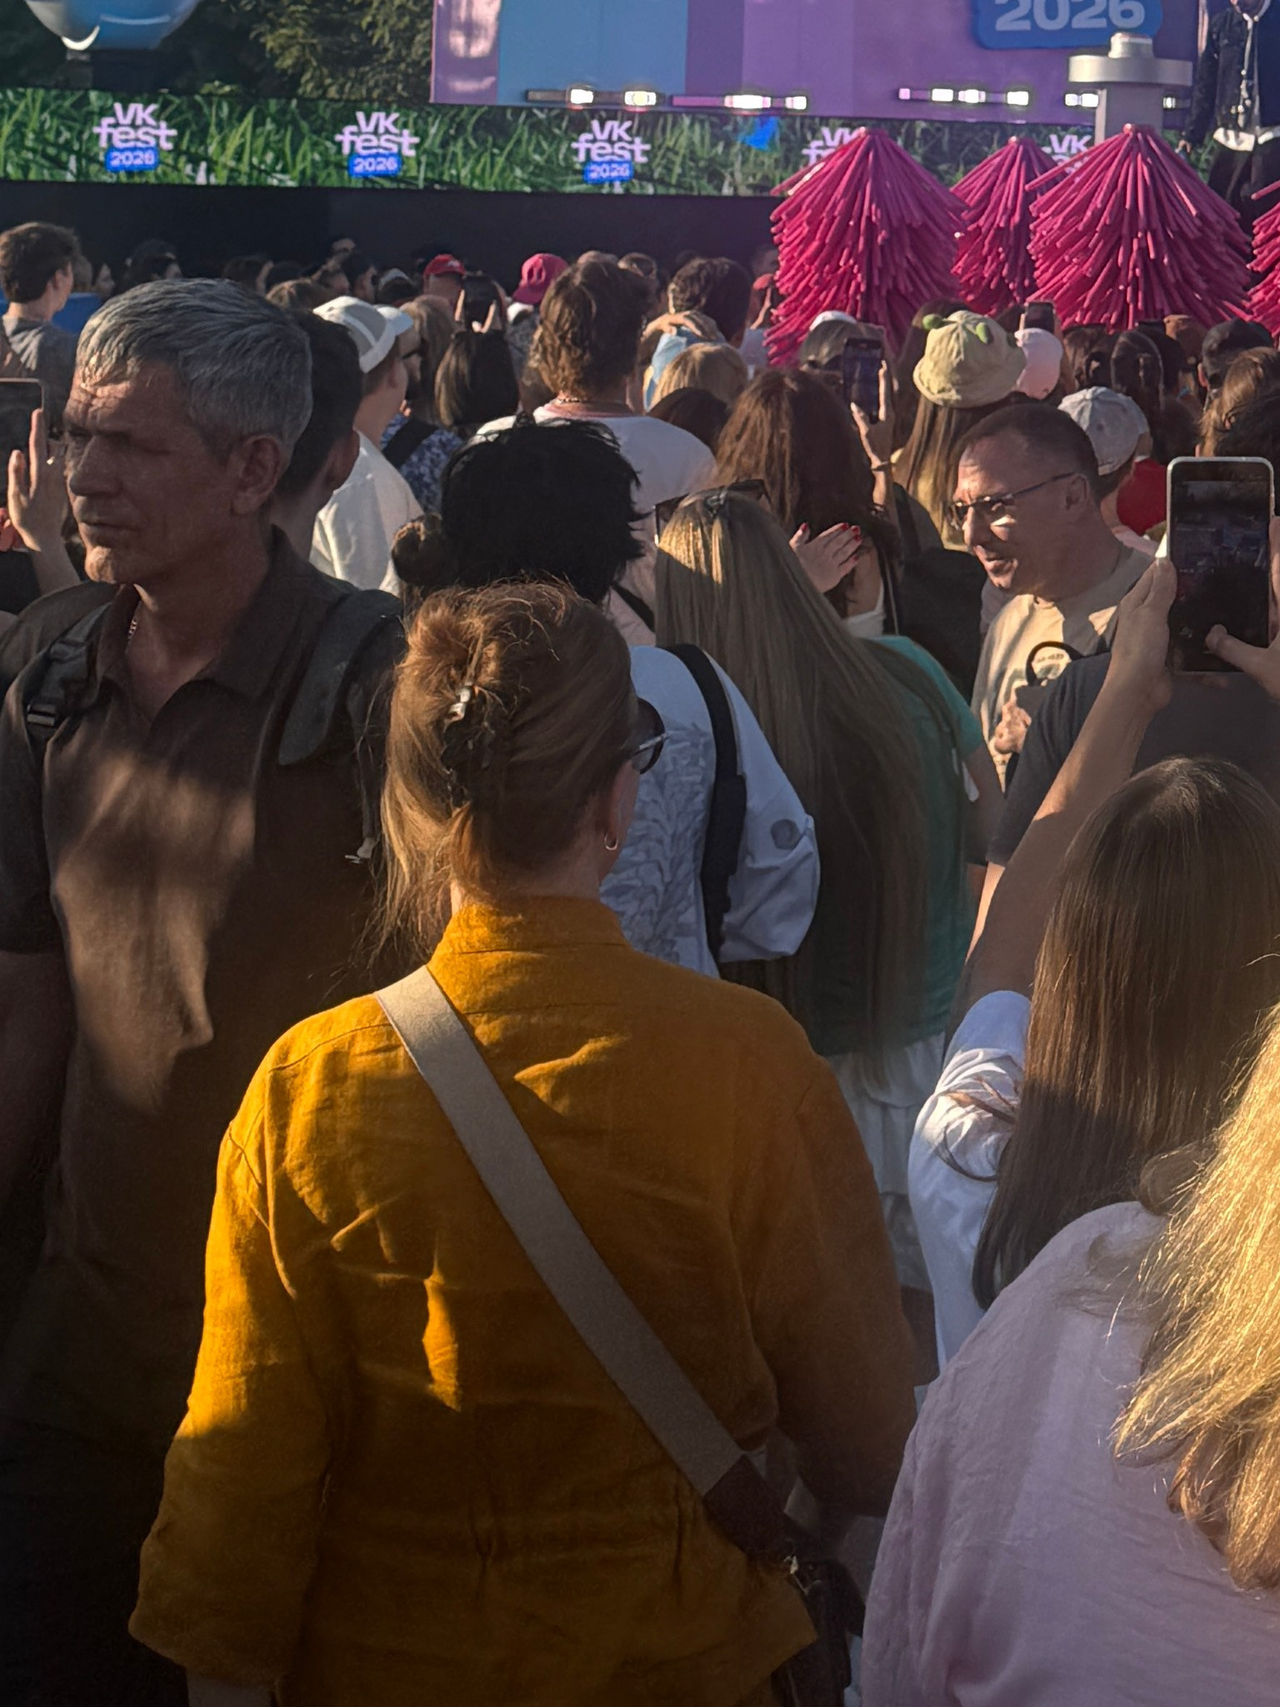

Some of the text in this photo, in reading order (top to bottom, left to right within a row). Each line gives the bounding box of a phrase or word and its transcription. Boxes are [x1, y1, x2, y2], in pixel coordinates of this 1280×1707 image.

[113, 102, 158, 126] VK
[355, 111, 400, 135] VK
[92, 117, 178, 150] fest
[333, 125, 420, 157] fest
[590, 119, 633, 142] VK
[570, 133, 651, 163] fest
[353, 156, 397, 173] 2026
